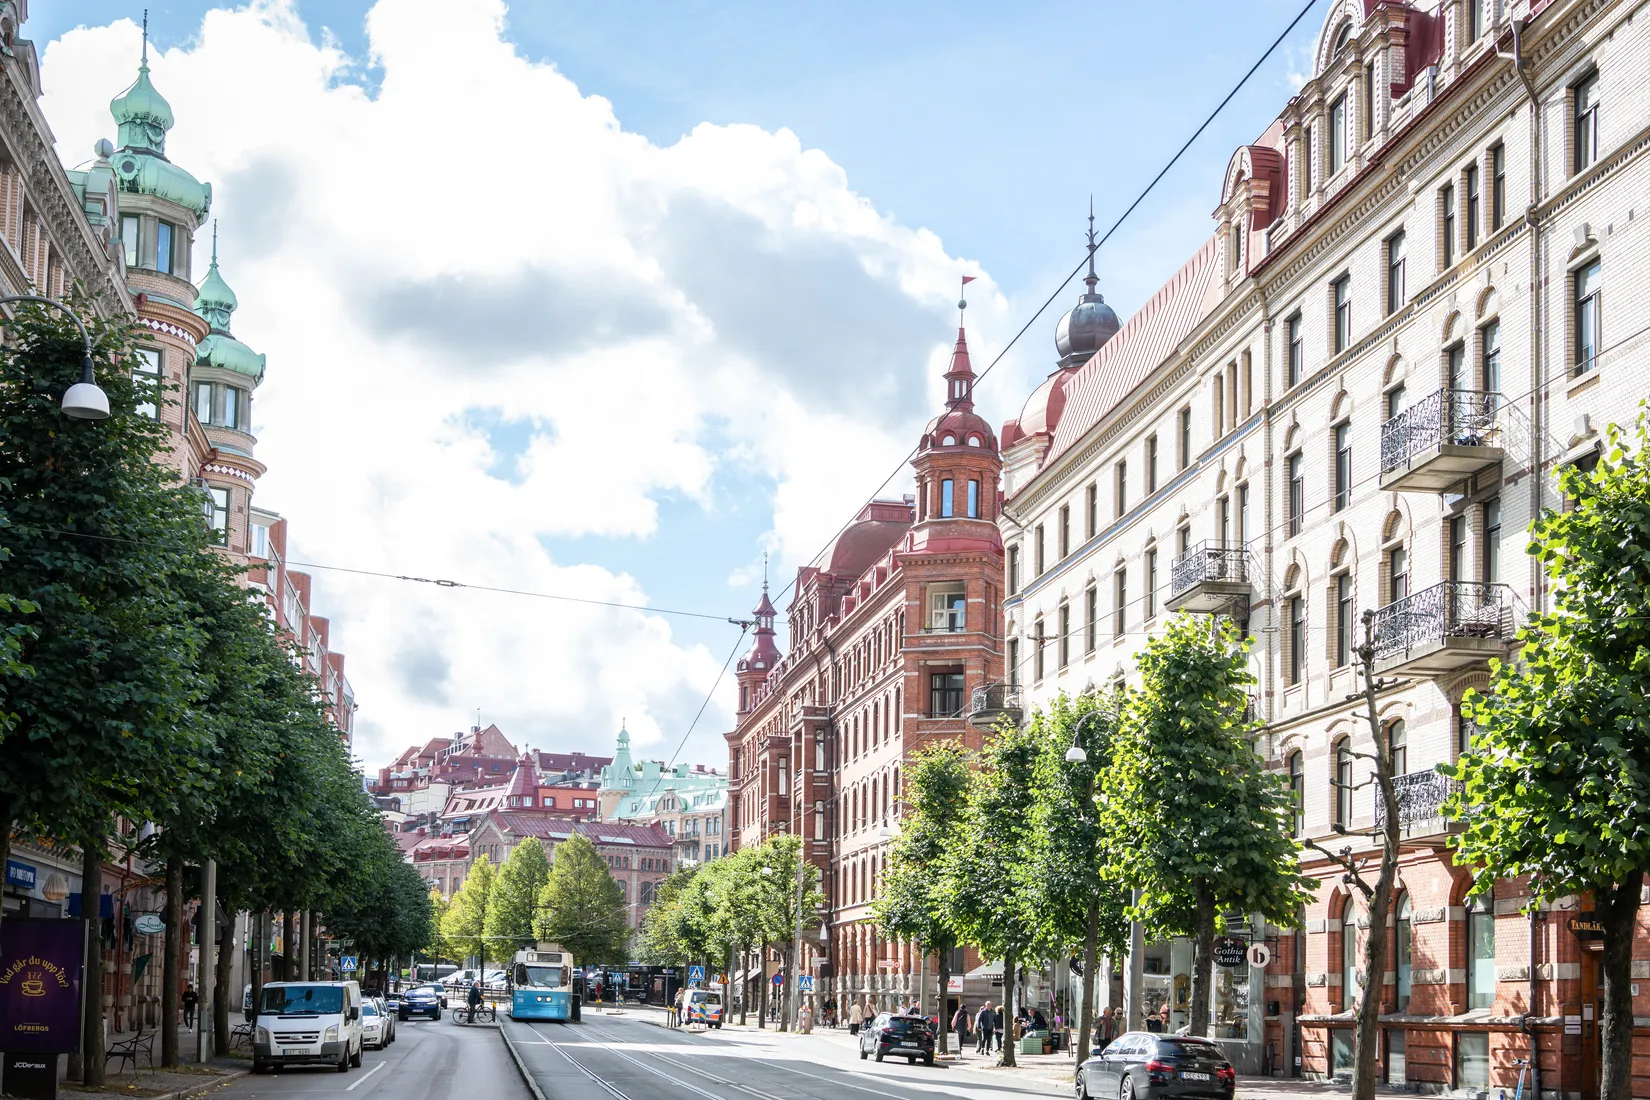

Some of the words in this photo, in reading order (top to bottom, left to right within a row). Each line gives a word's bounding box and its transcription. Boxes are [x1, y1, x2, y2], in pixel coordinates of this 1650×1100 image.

[1571, 919, 1604, 931] TANDLÄK
[1214, 946, 1244, 955] Gothia
[1216, 955, 1241, 964] Antik
[0, 968, 15, 985] Vad
[12, 959, 27, 973] går
[28, 955, 41, 965] du
[42, 959, 58, 973] upp
[55, 969, 69, 988] för?
[14, 1024, 50, 1032] LÖFBERGS
